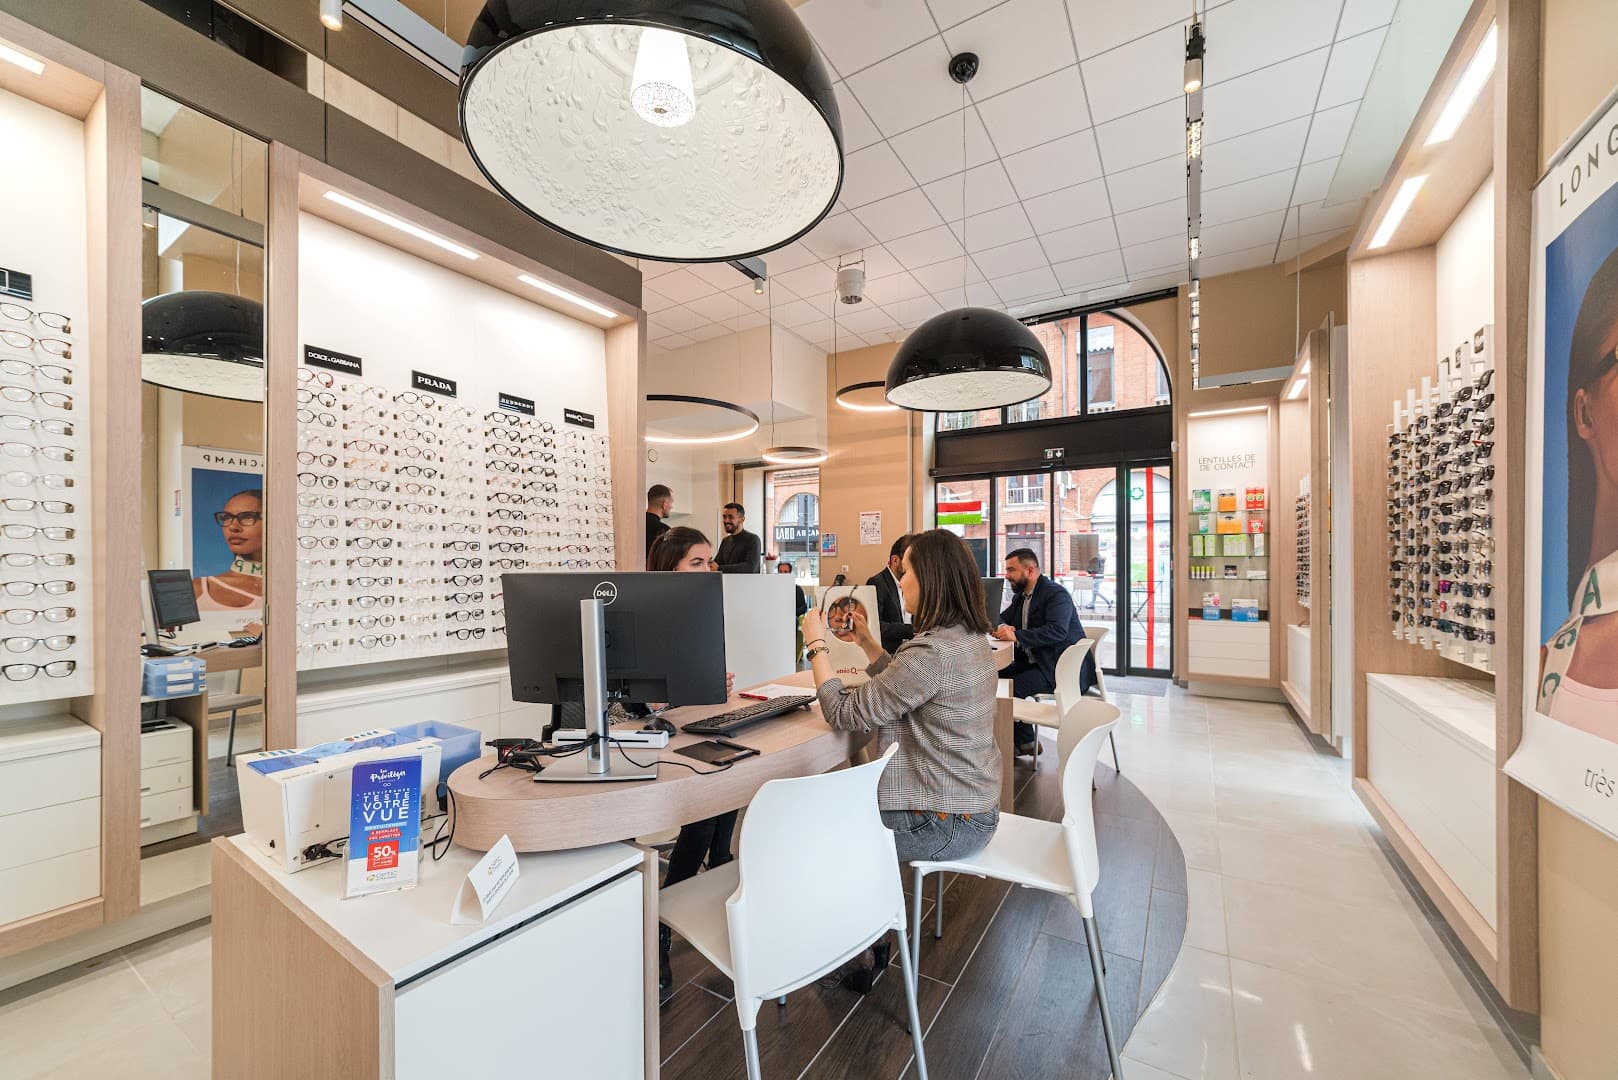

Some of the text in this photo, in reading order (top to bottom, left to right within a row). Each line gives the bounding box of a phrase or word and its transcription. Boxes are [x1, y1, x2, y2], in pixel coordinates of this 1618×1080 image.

[417, 375, 453, 391] PRADA
[1198, 453, 1257, 465] LENTILLES DE
[1214, 461, 1255, 471] CONTACT
[1584, 768, 1615, 798] très
[363, 792, 410, 803] TESTE
[363, 799, 409, 811] VOTRE
[363, 807, 409, 823] VUE
